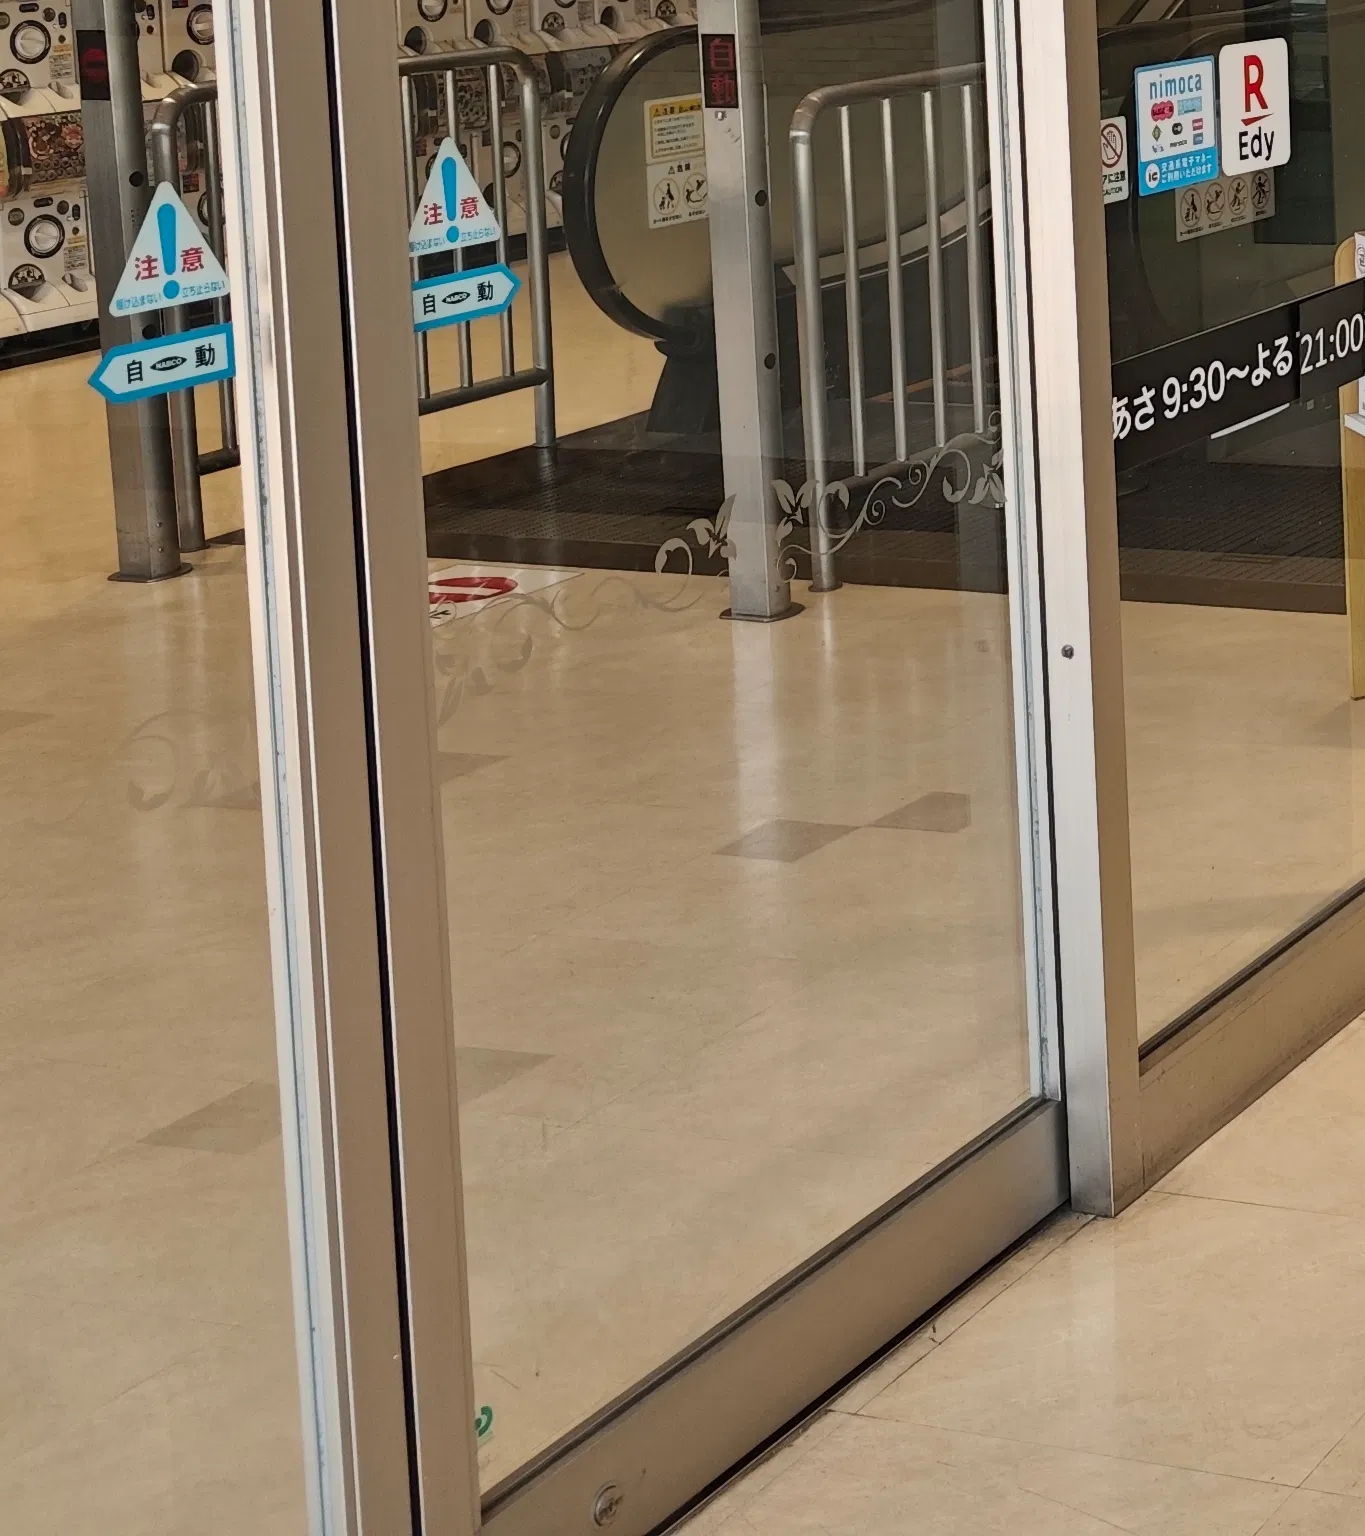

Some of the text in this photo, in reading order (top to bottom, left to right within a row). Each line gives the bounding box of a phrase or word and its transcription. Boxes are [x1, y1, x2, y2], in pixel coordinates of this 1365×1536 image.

[710, 38, 735, 105] 自動
[1150, 73, 1202, 100] nimoca
[1244, 55, 1268, 112] R
[1239, 126, 1275, 161] Edy
